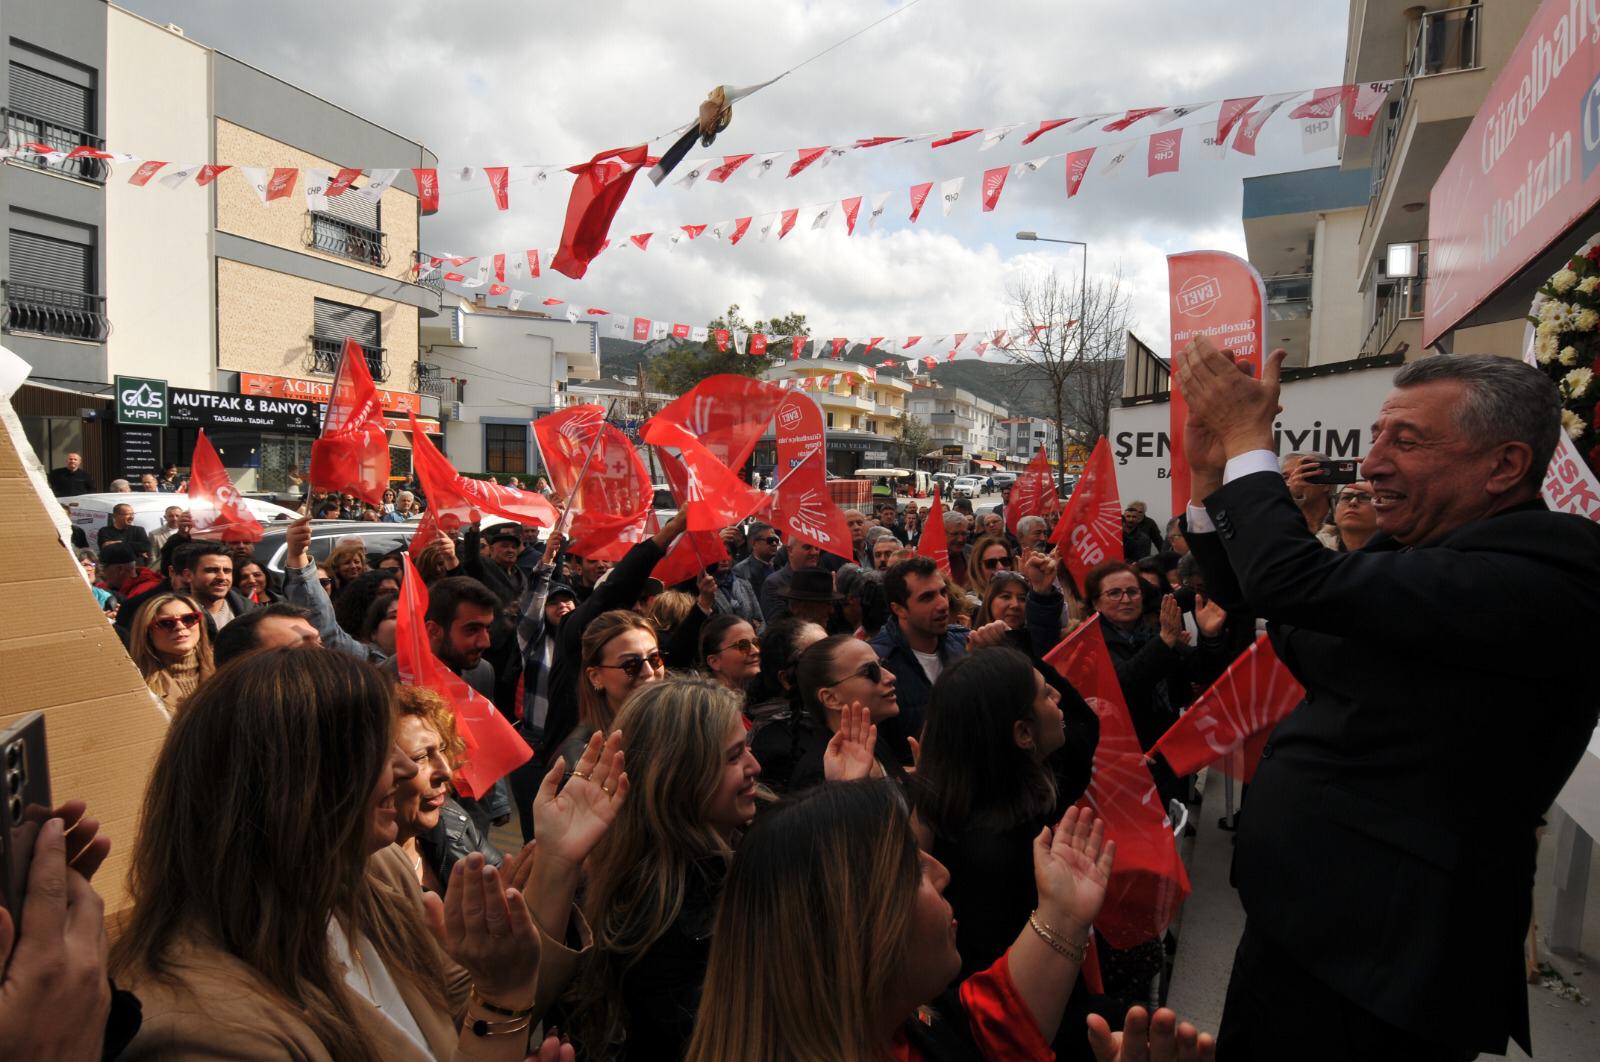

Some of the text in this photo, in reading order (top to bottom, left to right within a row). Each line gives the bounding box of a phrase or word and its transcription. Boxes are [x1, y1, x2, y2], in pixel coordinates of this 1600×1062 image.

[307, 186, 321, 195] CHP
[124, 409, 161, 420] YAPI
[173, 392, 308, 415] MUTFAK & BANYO
[213, 415, 242, 423] TASARIM
[1274, 421, 1361, 457] İYİM
[788, 516, 831, 544] CHP
[1071, 524, 1104, 565] CHP
